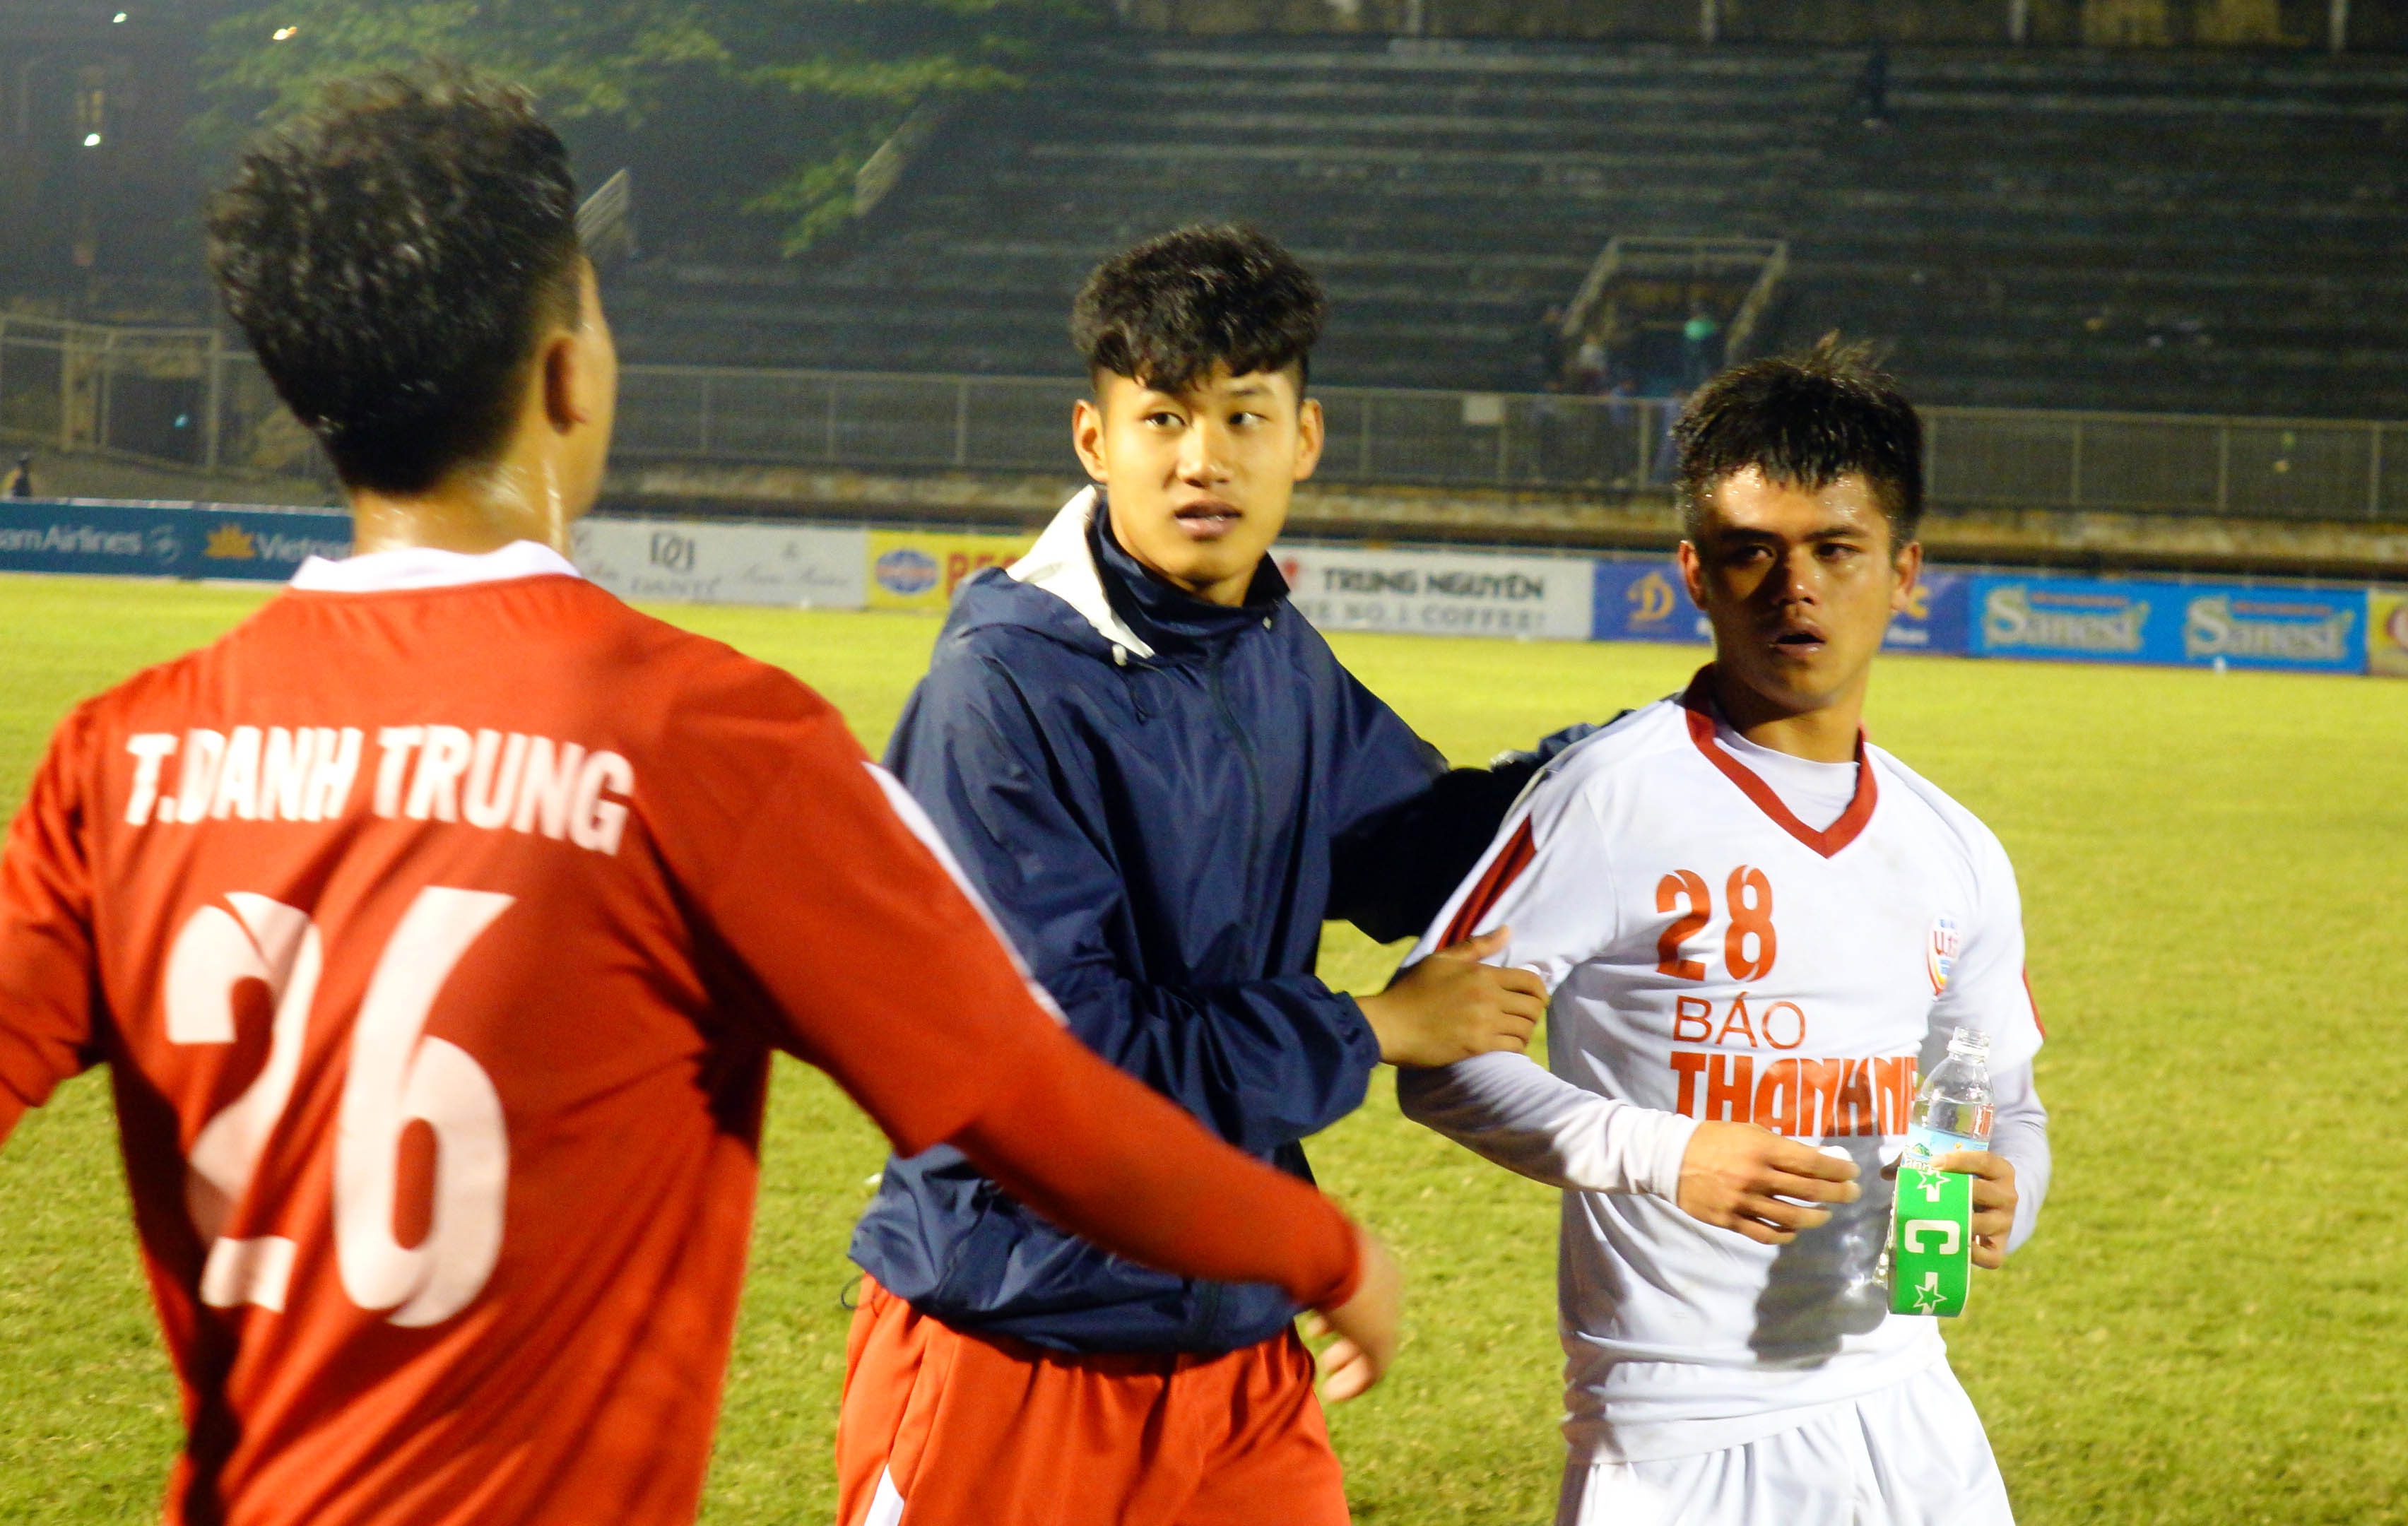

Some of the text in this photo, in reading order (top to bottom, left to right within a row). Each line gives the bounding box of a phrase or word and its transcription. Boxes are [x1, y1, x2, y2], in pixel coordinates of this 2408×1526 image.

[1323, 568, 1417, 593] TRUNG
[125, 724, 635, 856] T.DANH TRUNG
[1656, 864, 1777, 982] 28
[1672, 991, 1806, 1050] BÁO
[164, 885, 518, 1328] 26
[1904, 1219, 1960, 1255] C
